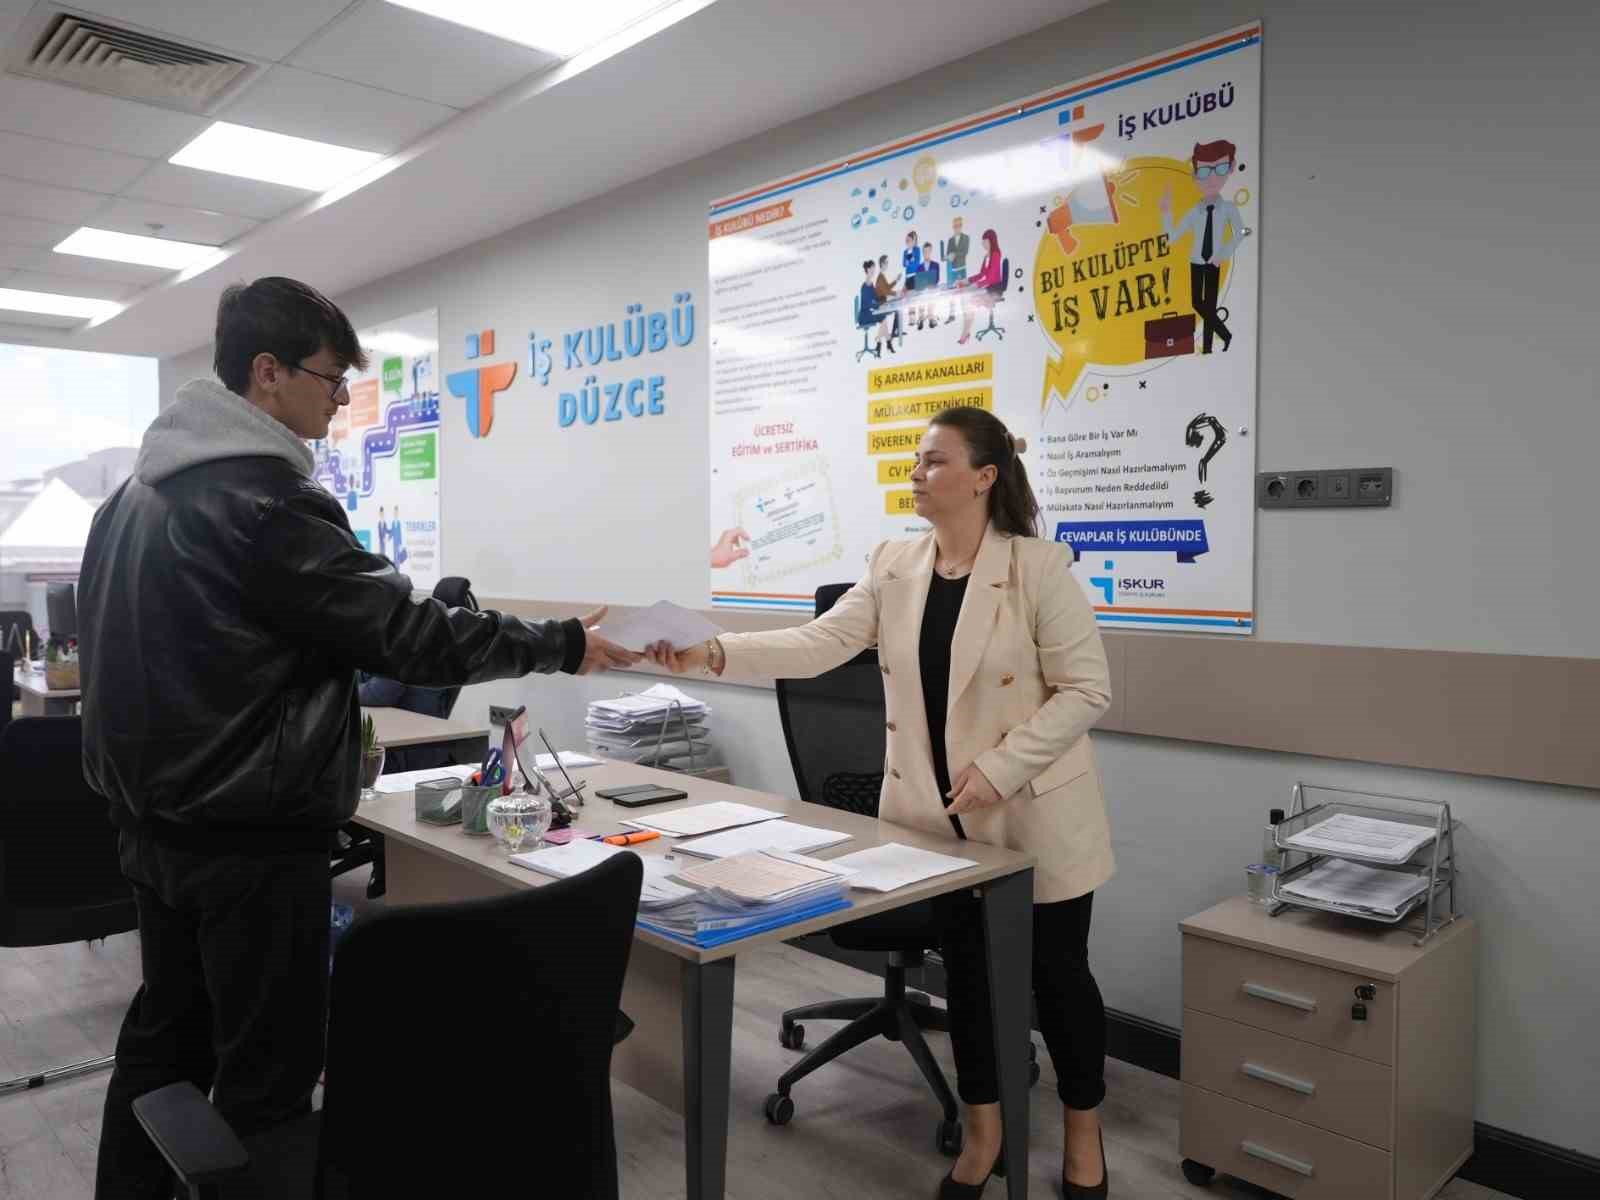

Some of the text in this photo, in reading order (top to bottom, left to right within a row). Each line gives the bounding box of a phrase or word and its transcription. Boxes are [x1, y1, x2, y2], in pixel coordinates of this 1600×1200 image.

[1118, 81, 1235, 140] İŞ KULÜBÜ
[1041, 233, 1171, 293] BU KULÜPTE
[1053, 266, 1172, 335] İŞ VAR!
[528, 331, 553, 386] İŞ
[563, 291, 695, 370] KULÜBÜ
[873, 360, 985, 389] İŞ ARAMA KANALLARI
[558, 375, 665, 428] DÜZCE
[873, 401, 922, 418] MÜLAKAT
[752, 421, 794, 437] ÜCRETSİZ
[1088, 431, 1100, 441] Bir
[1110, 430, 1125, 439] Var
[775, 438, 818, 453] SERTİFİKA
[871, 434, 913, 450] İŞVEREN
[889, 466, 902, 477] CV
[1100, 465, 1120, 475] Nasıl
[1122, 463, 1187, 474] Hazırlamalıyım
[1094, 483, 1122, 493] Neden
[1123, 481, 1169, 492] Reddedildi
[1046, 501, 1174, 512] Mülakata Nasıl Hazırlanmalıyım
[1060, 528, 1202, 544] CEVAPLAR İŞ KULÜBÜNDE
